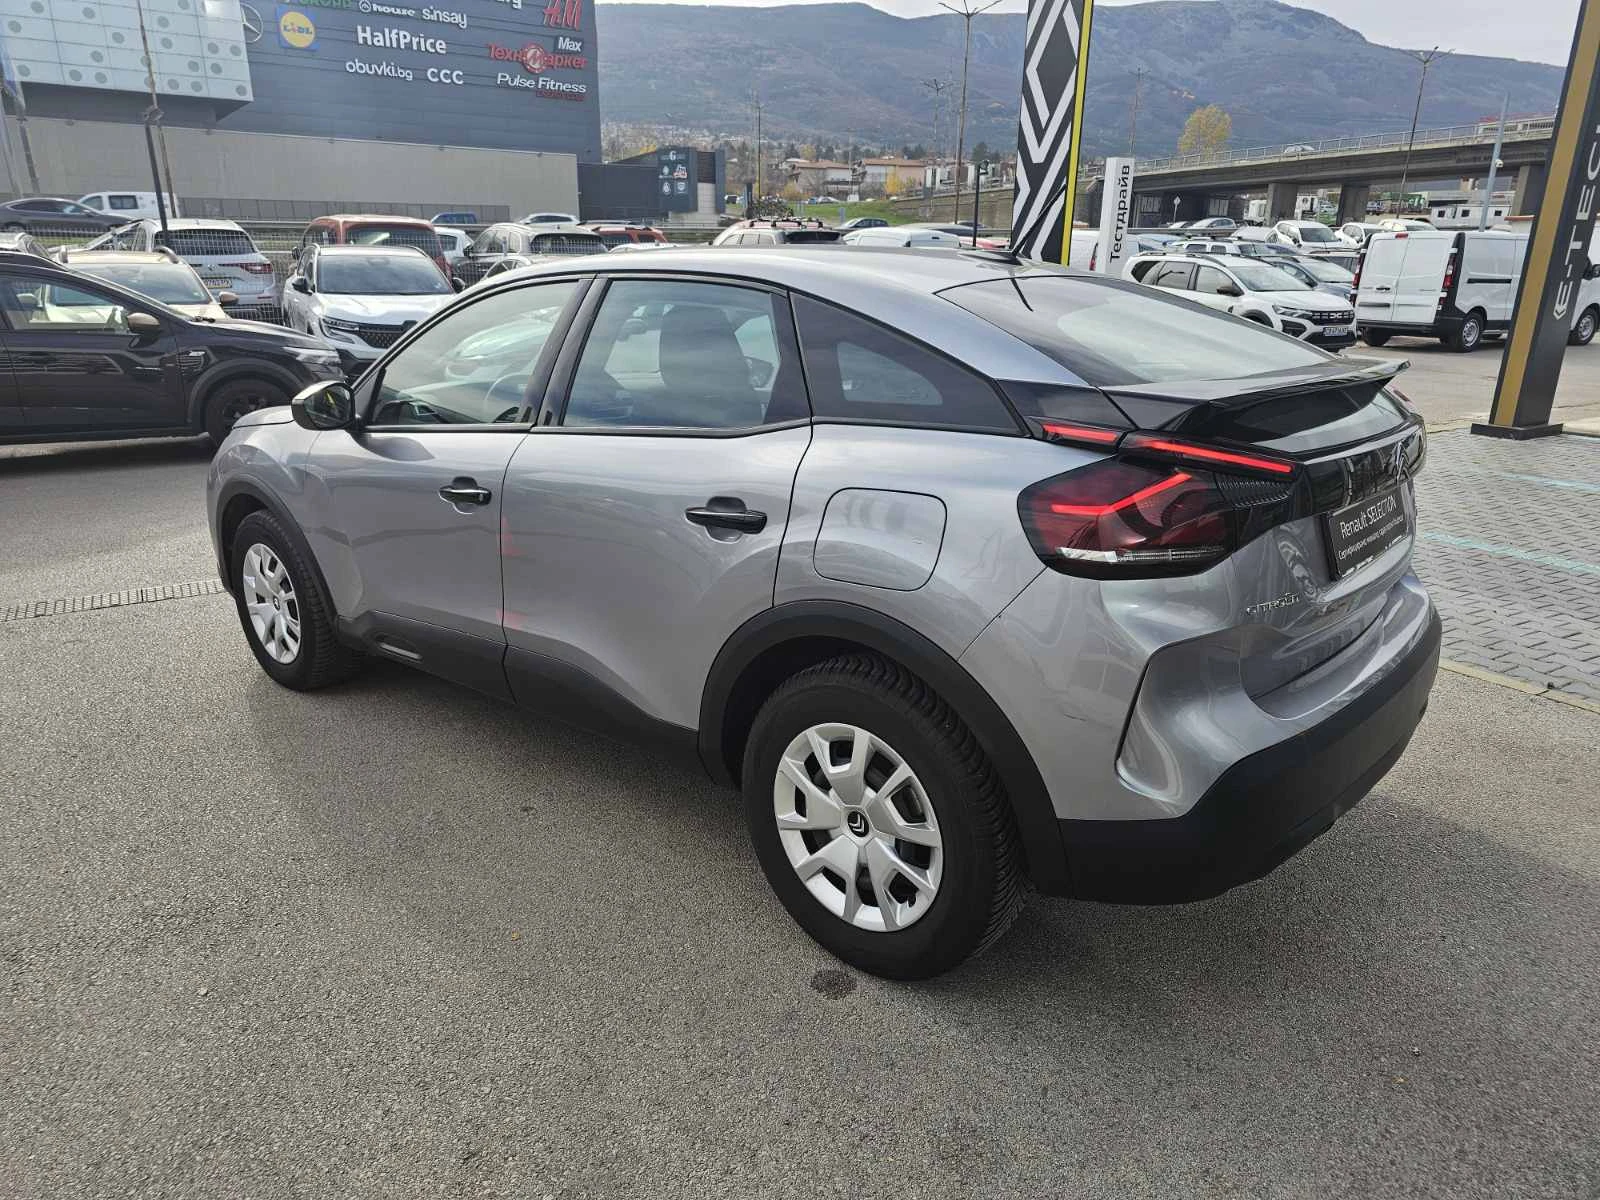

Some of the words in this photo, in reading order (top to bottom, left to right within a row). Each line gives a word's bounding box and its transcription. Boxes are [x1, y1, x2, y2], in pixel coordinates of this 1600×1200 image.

[422, 6, 468, 29] sinsay
[356, 25, 447, 54] HalfPrice
[558, 36, 582, 52] Max
[345, 58, 413, 81] obuvki.bg
[496, 72, 536, 88] Pulse
[537, 76, 587, 93] Fitness
[1110, 165, 1130, 263] Тестдрайв
[1553, 124, 1600, 320] E-TEC
[1339, 511, 1369, 539] Renault
